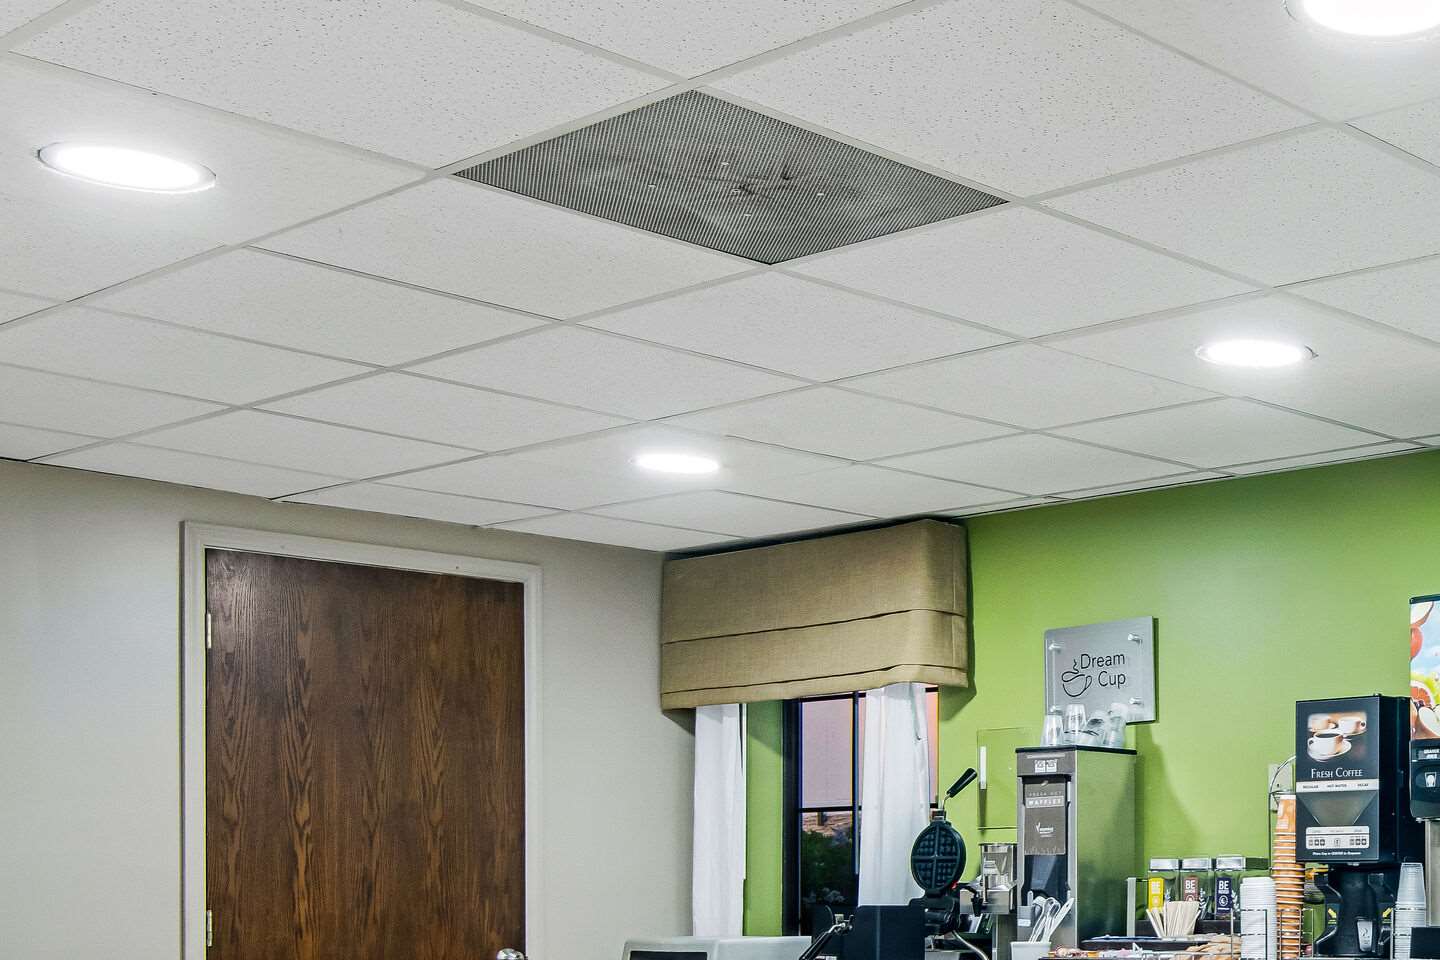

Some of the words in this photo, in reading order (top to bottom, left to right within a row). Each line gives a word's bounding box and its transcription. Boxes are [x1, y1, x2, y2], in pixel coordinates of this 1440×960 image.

[1080, 653, 1125, 670] Dream
[1098, 670, 1126, 689] Cup
[1311, 768, 1334, 779] FRESH
[1335, 767, 1363, 778] COFFEE
[1185, 880, 1196, 889] BE
[1218, 880, 1230, 890] BE
